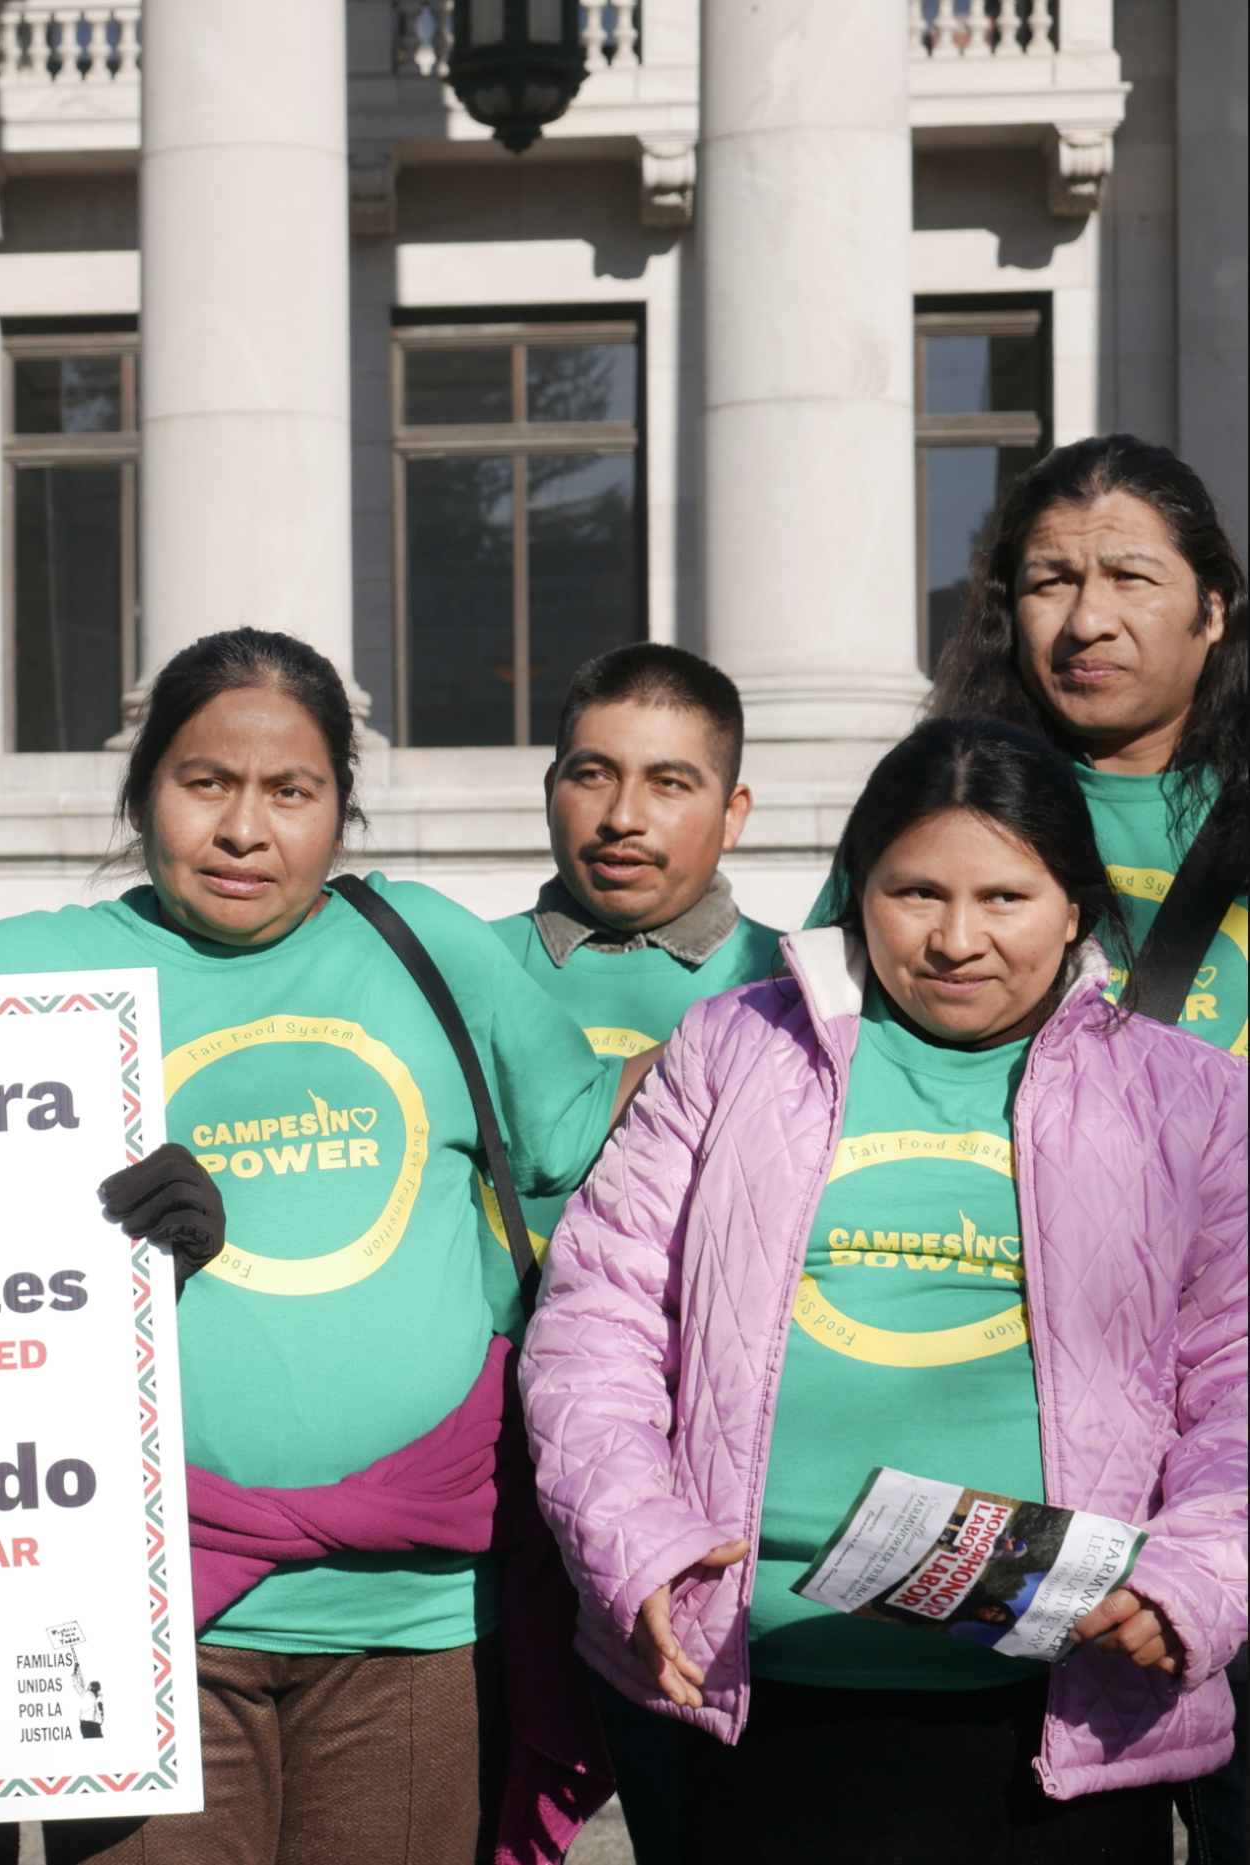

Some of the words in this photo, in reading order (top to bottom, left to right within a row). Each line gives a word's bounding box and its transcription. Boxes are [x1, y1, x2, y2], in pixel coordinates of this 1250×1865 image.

[1114, 875, 1135, 887] od
[187, 1041, 223, 1061] Fair
[232, 1022, 276, 1042] Food
[286, 1022, 354, 1040] System
[591, 1035, 610, 1047] od
[194, 1138, 380, 1178] POWER
[848, 1142, 886, 1160] Fair
[898, 1137, 946, 1150] Food
[956, 1140, 1015, 1166] Syste
[363, 1178, 416, 1257] Transition
[220, 1253, 253, 1278] Foo
[813, 1313, 857, 1346] Food
[894, 1553, 958, 1607] LABOR
[919, 1558, 981, 1617] HONOR
[1046, 1534, 1104, 1625] LEGISLATIVE
[1028, 1624, 1053, 1650] DAY
[16, 1653, 73, 1670] FAMILIAS
[18, 1677, 63, 1694] UNIDAS
[19, 1703, 44, 1718] POR
[48, 1702, 62, 1717] LA
[20, 1726, 72, 1743] JUSTICIA
